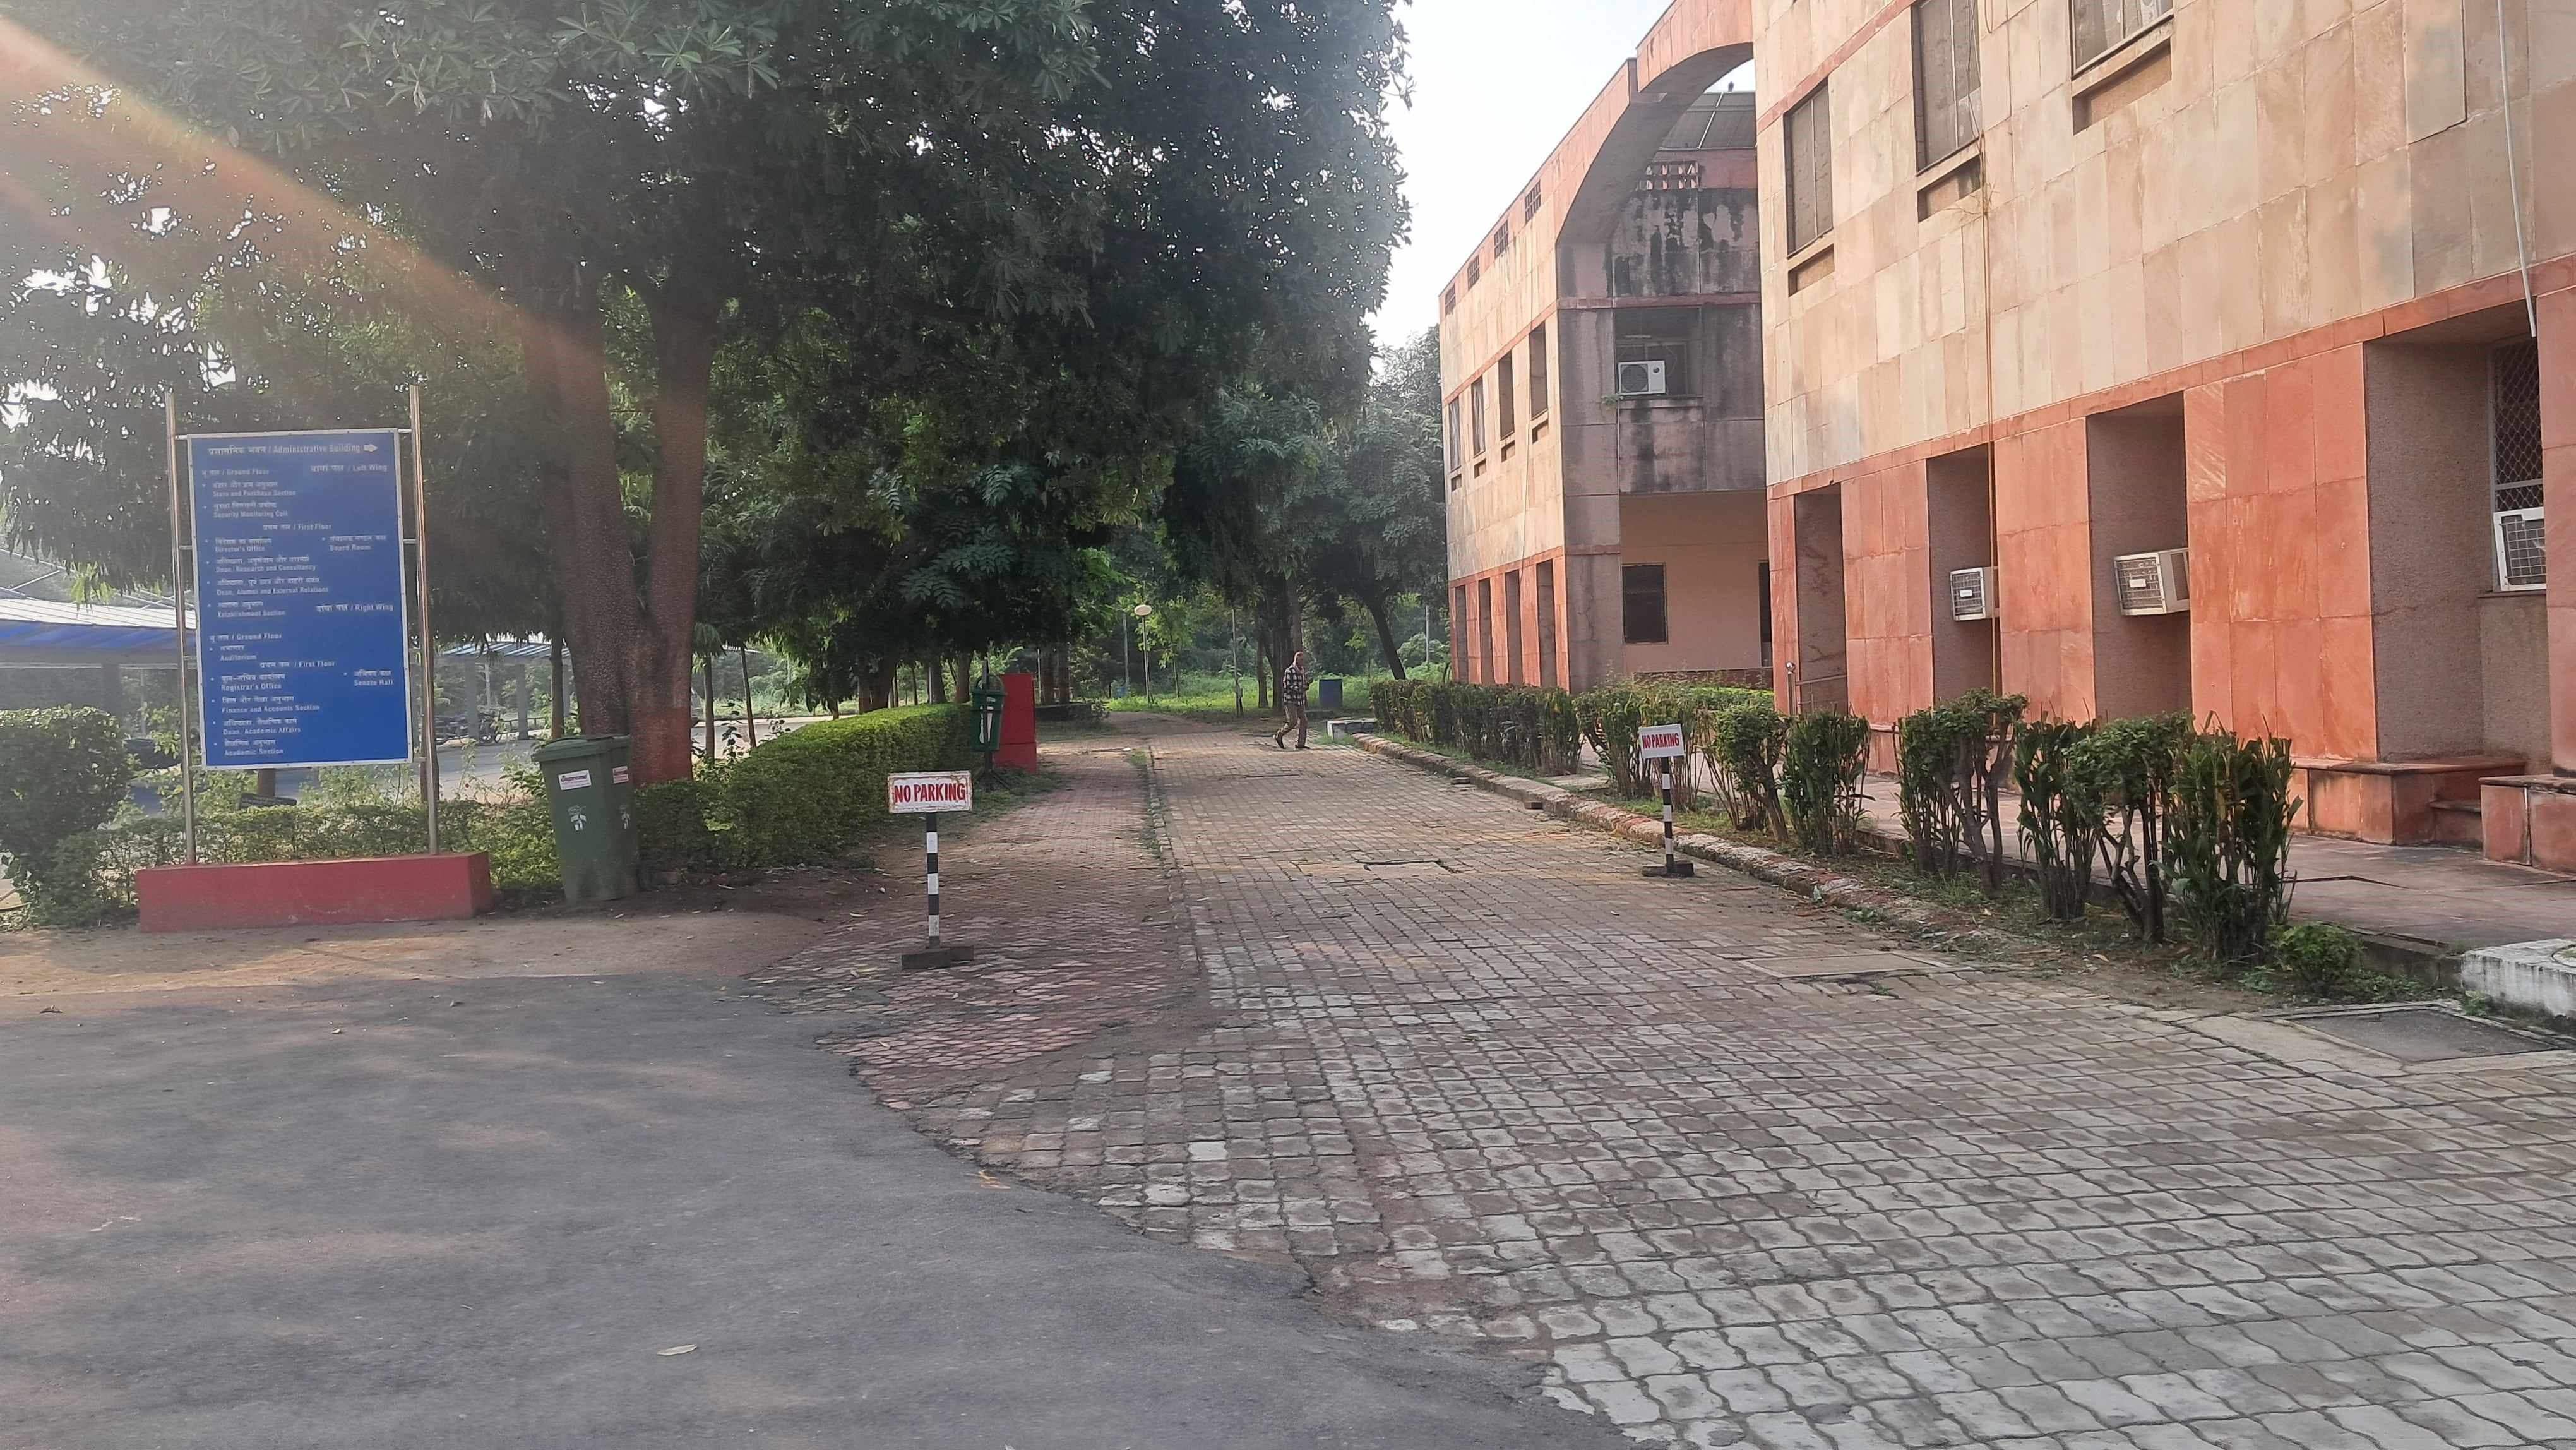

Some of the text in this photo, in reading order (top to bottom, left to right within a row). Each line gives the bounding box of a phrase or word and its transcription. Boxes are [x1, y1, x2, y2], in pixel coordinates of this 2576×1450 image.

[273, 445, 327, 453] Administrative
[329, 443, 360, 454] Building
[369, 464, 388, 473] Wing
[241, 510, 274, 518] Monitoring
[278, 564, 316, 572] Consultancy
[355, 604, 373, 613] Right
[375, 603, 394, 613] Wing
[221, 684, 258, 692] Registrar's
[1642, 733, 1679, 748] NO PARKING
[894, 782, 966, 803] NO PARKING
